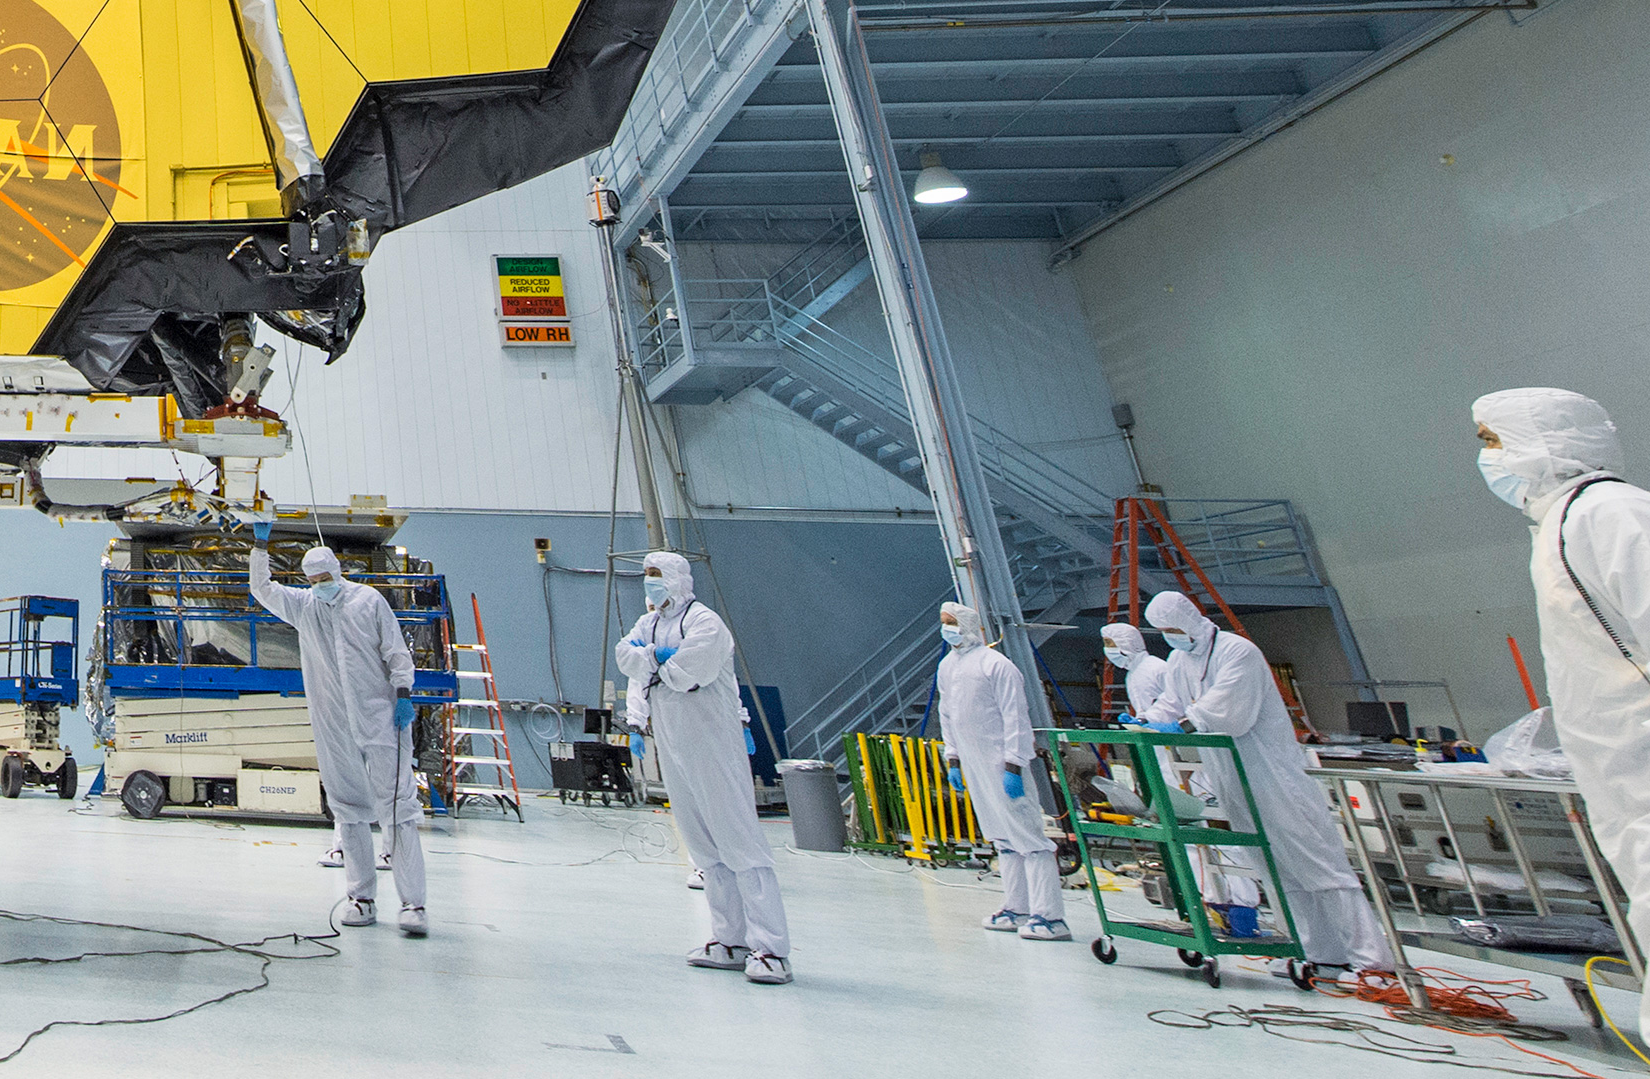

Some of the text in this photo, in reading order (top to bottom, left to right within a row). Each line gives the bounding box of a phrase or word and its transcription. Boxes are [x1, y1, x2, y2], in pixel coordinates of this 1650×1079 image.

[506, 327, 570, 341] LOW RH
[165, 732, 208, 744] Marklift
[259, 785, 297, 795] CH26NEP
